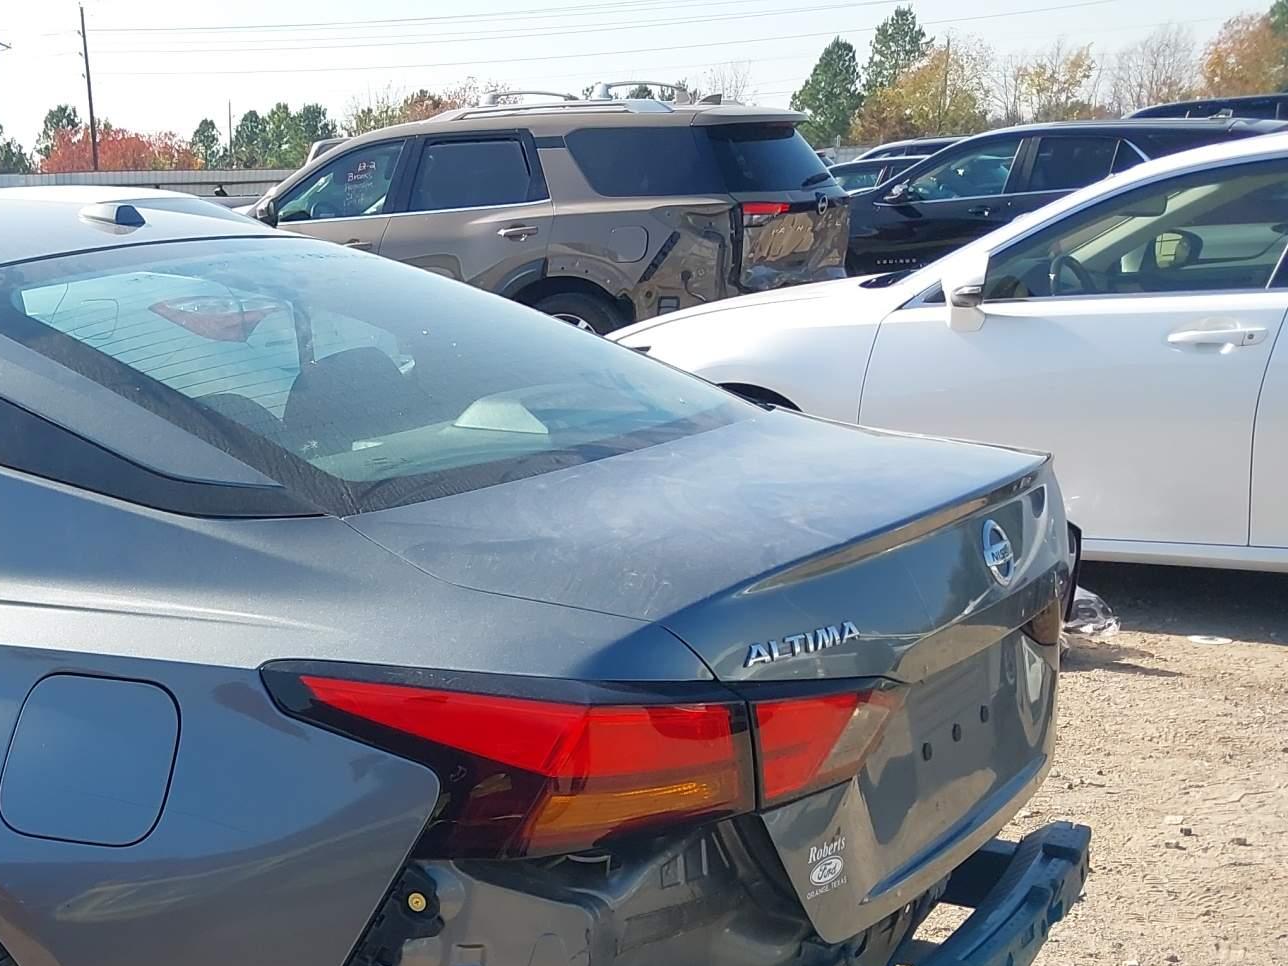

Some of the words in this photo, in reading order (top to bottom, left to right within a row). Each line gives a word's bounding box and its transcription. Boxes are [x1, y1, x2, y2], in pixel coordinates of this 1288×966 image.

[743, 621, 860, 668] ALTIMA
[808, 836, 846, 864] Roberts
[831, 875, 848, 889] TEXAS
